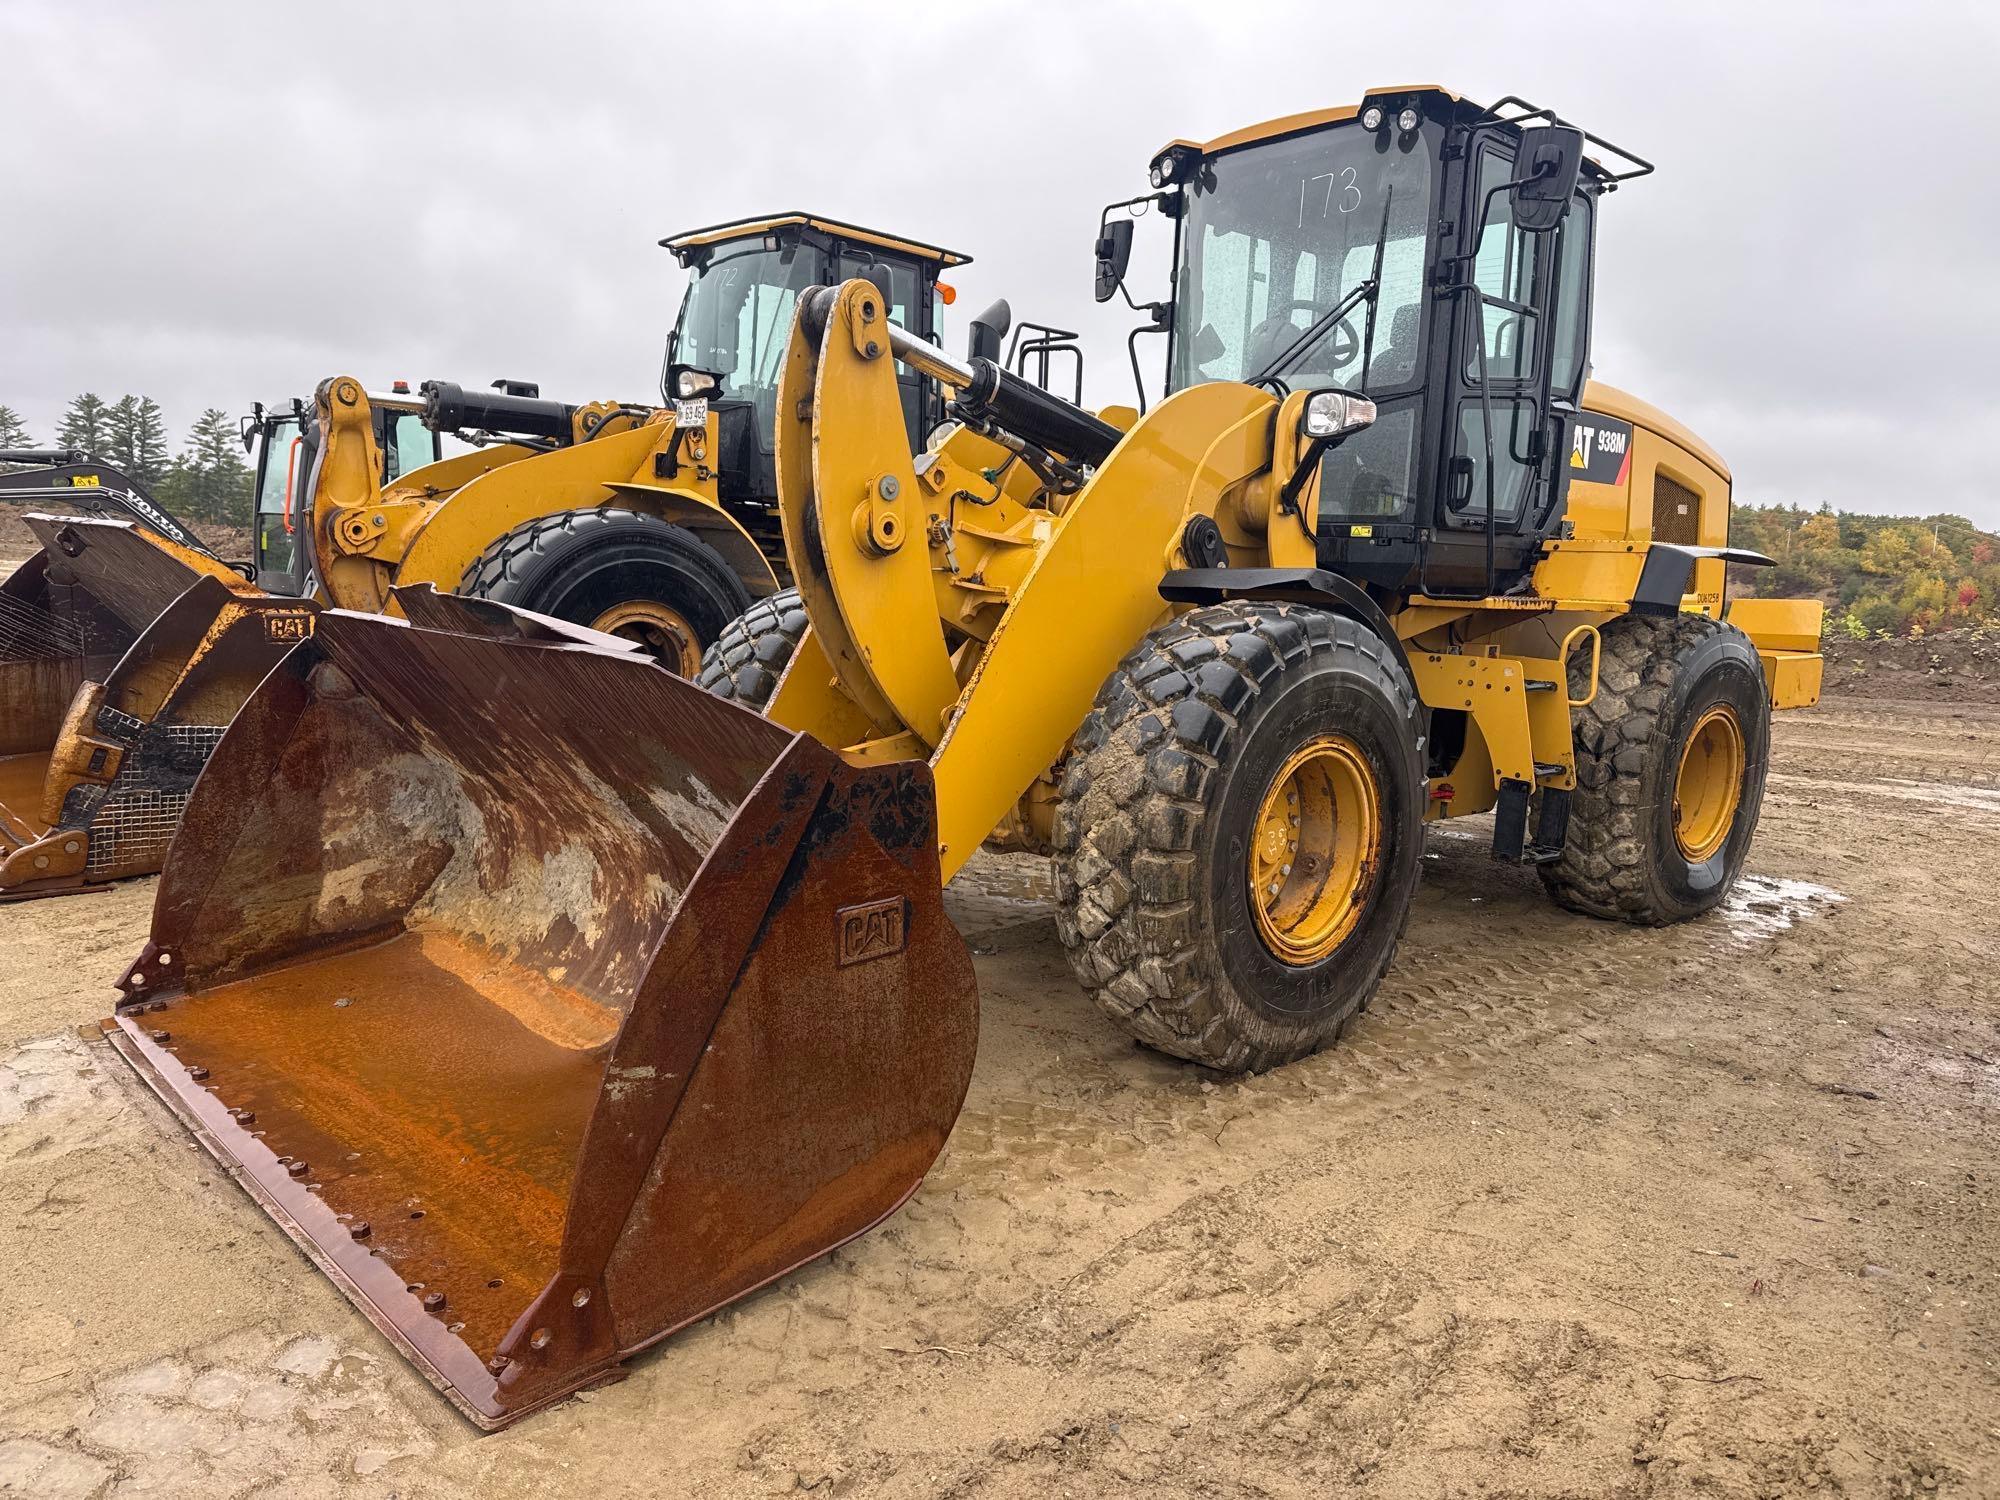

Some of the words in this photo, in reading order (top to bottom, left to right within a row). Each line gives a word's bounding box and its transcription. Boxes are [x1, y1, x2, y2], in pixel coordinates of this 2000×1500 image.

[1298, 166, 1361, 229] 173
[713, 267, 738, 287] 172
[1571, 424, 1595, 470] AT
[1597, 429, 1626, 454] 938M
[126, 487, 184, 541] VOLVO
[271, 618, 306, 639] CAT
[844, 905, 900, 958] CAT
